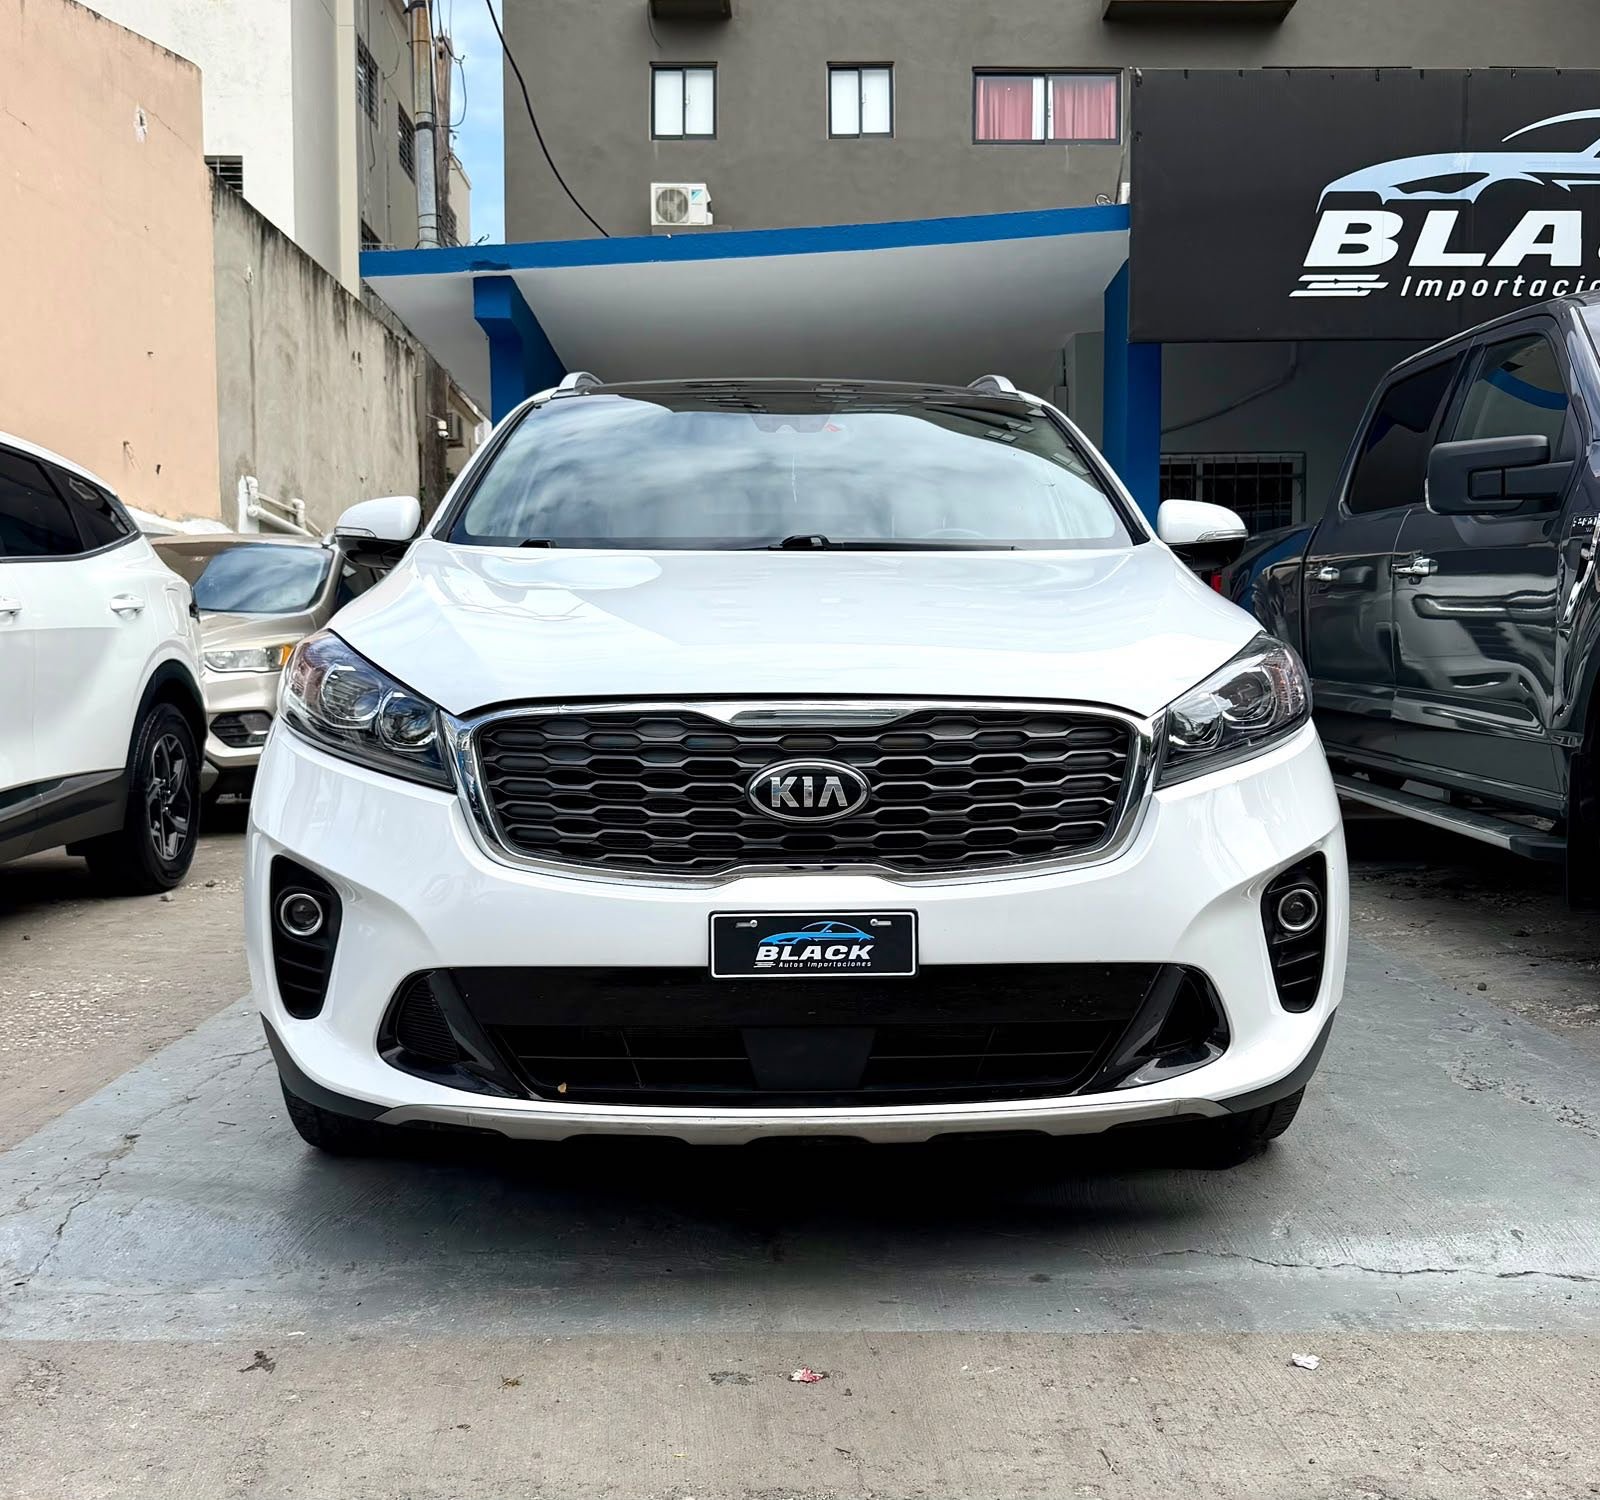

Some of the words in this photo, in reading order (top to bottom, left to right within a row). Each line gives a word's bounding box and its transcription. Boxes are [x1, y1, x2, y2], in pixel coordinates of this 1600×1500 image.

[1303, 210, 1600, 267] BLA
[769, 776, 848, 808] KIA
[755, 944, 875, 961] BLACK
[807, 961, 872, 969] Importaciones
